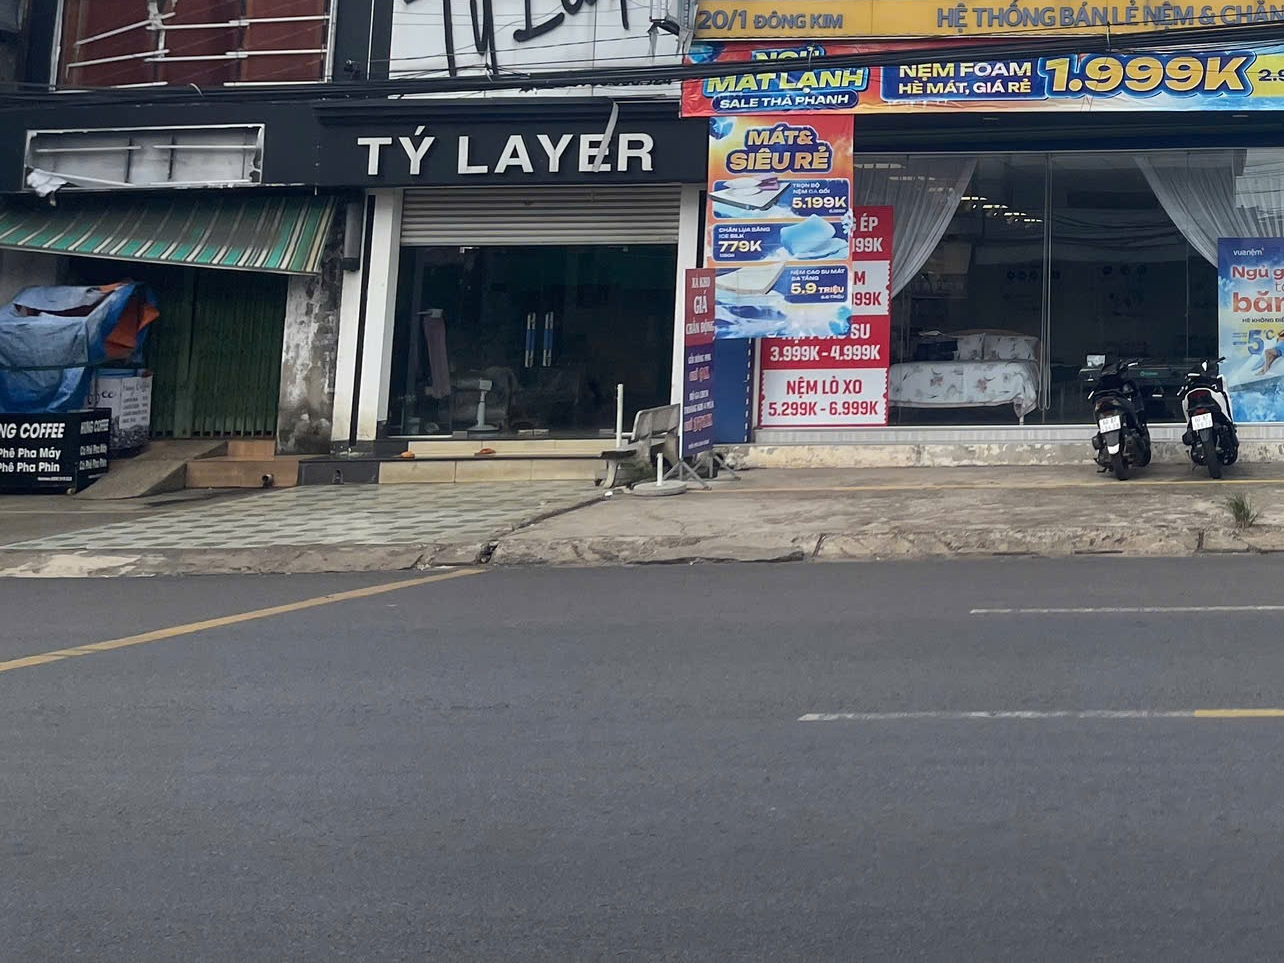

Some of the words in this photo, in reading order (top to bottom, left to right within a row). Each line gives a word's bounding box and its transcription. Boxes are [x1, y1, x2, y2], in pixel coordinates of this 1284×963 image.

[754, 10, 806, 30] ĐÔNG
[810, 13, 843, 29] KIM
[937, 3, 968, 33] HỆ
[960, 62, 1031, 77] FOAM
[1046, 55, 1249, 92] 1.999K
[780, 68, 864, 93] LẠNH
[899, 80, 923, 94] HÈ
[926, 80, 970, 95] MÁT,
[973, 79, 1005, 93] GIÁ
[1008, 78, 1031, 93] RẺ
[719, 98, 759, 109] SALE
[762, 94, 793, 107] THẢ
[795, 94, 849, 106] PHANH
[747, 126, 813, 146] MÁT&
[357, 125, 435, 175] TÝ
[457, 133, 654, 174] LAYER
[729, 148, 790, 170] SIÊU
[794, 146, 829, 170] RẺ
[792, 196, 847, 209] 5.199K
[860, 213, 879, 232] ÉP
[718, 240, 762, 252] 779K
[1232, 265, 1269, 280] Ngủ
[791, 282, 817, 294] 5.9
[850, 323, 871, 339] SU
[770, 345, 820, 361] 3.999K
[830, 344, 880, 360] 4.999K
[786, 375, 818, 399] NỆM
[822, 375, 839, 394] LÒ
[842, 379, 863, 394] XO
[768, 402, 817, 416] 5.299K
[829, 400, 879, 415] 6.999K
[20, 423, 65, 438] COFFEE
[18, 448, 37, 458] Pha
[39, 447, 61, 460] Máy
[17, 462, 36, 472] Pha
[38, 462, 60, 472] Phin
